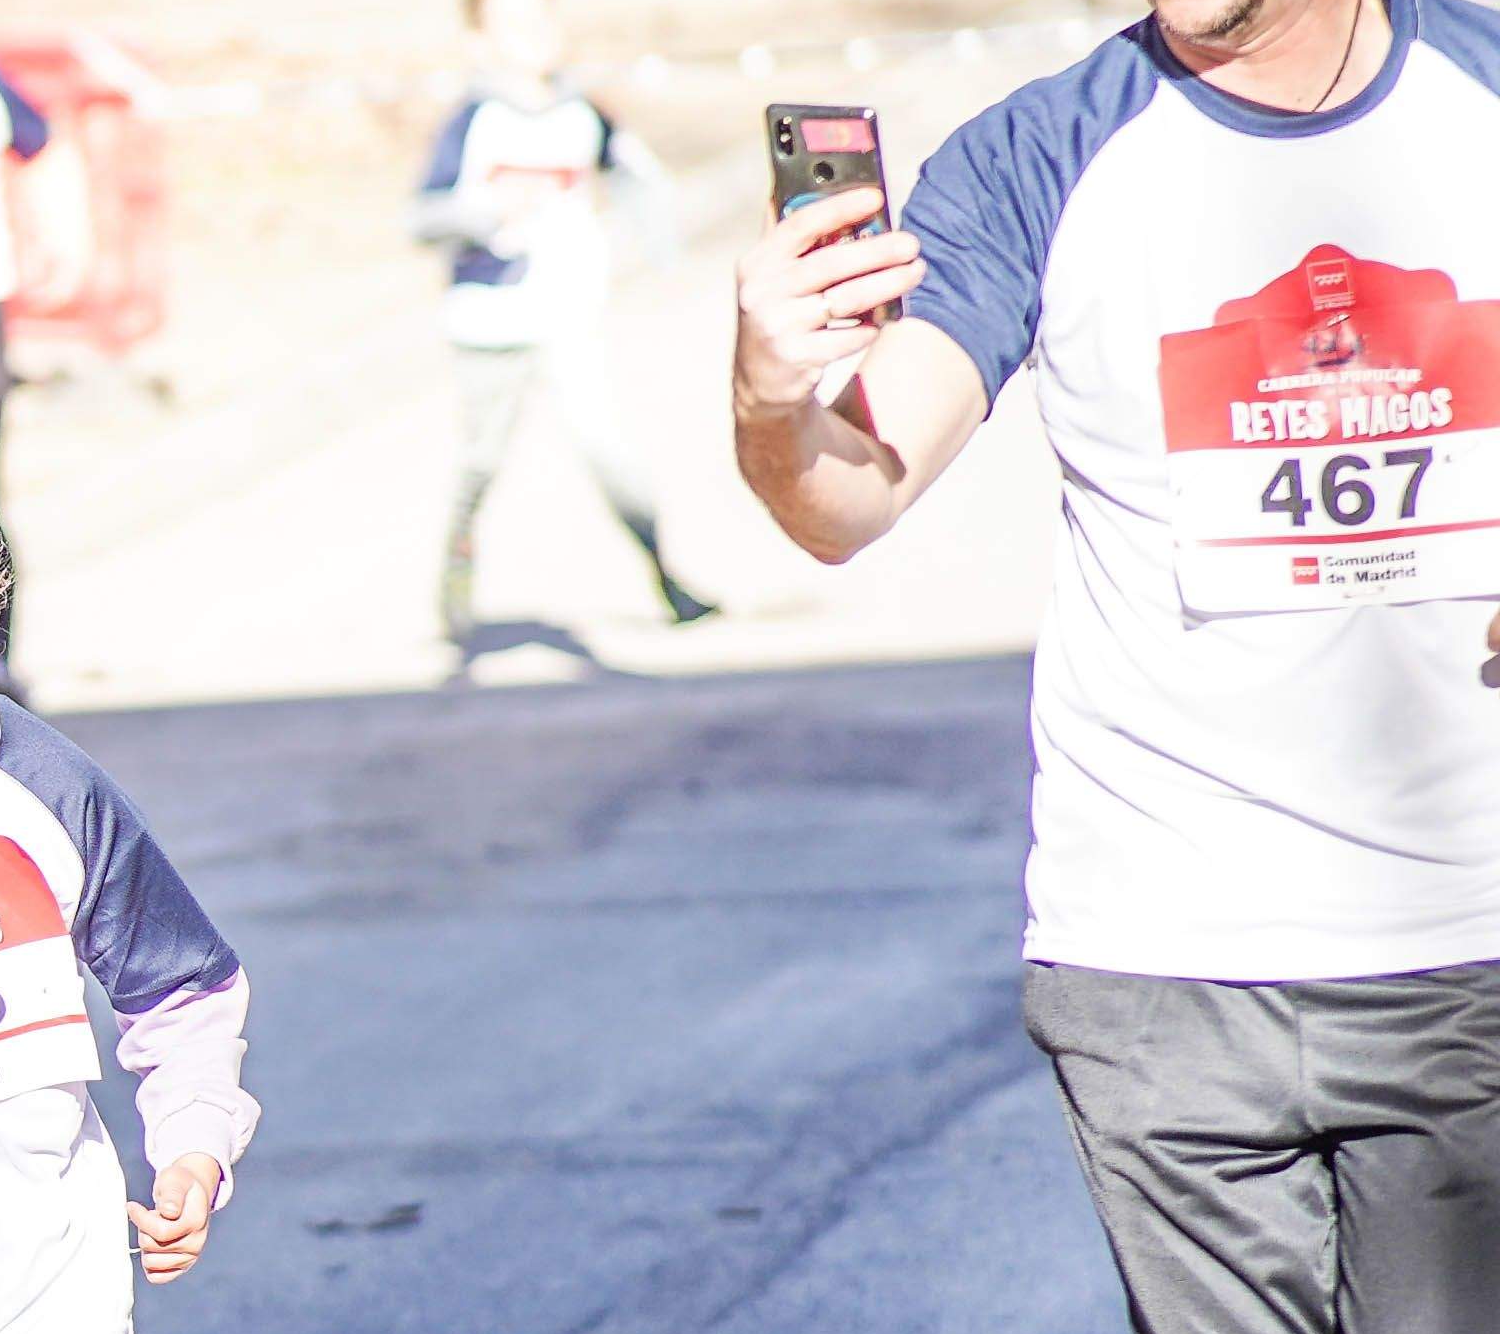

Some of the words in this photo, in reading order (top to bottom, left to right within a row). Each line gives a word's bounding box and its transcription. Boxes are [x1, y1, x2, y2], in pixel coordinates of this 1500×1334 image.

[1230, 400, 1330, 443] REYES
[1339, 387, 1453, 439] MAGOS
[1261, 446, 1434, 527] 467
[1324, 550, 1415, 566] Comunidad
[1355, 567, 1417, 582] Madrid
